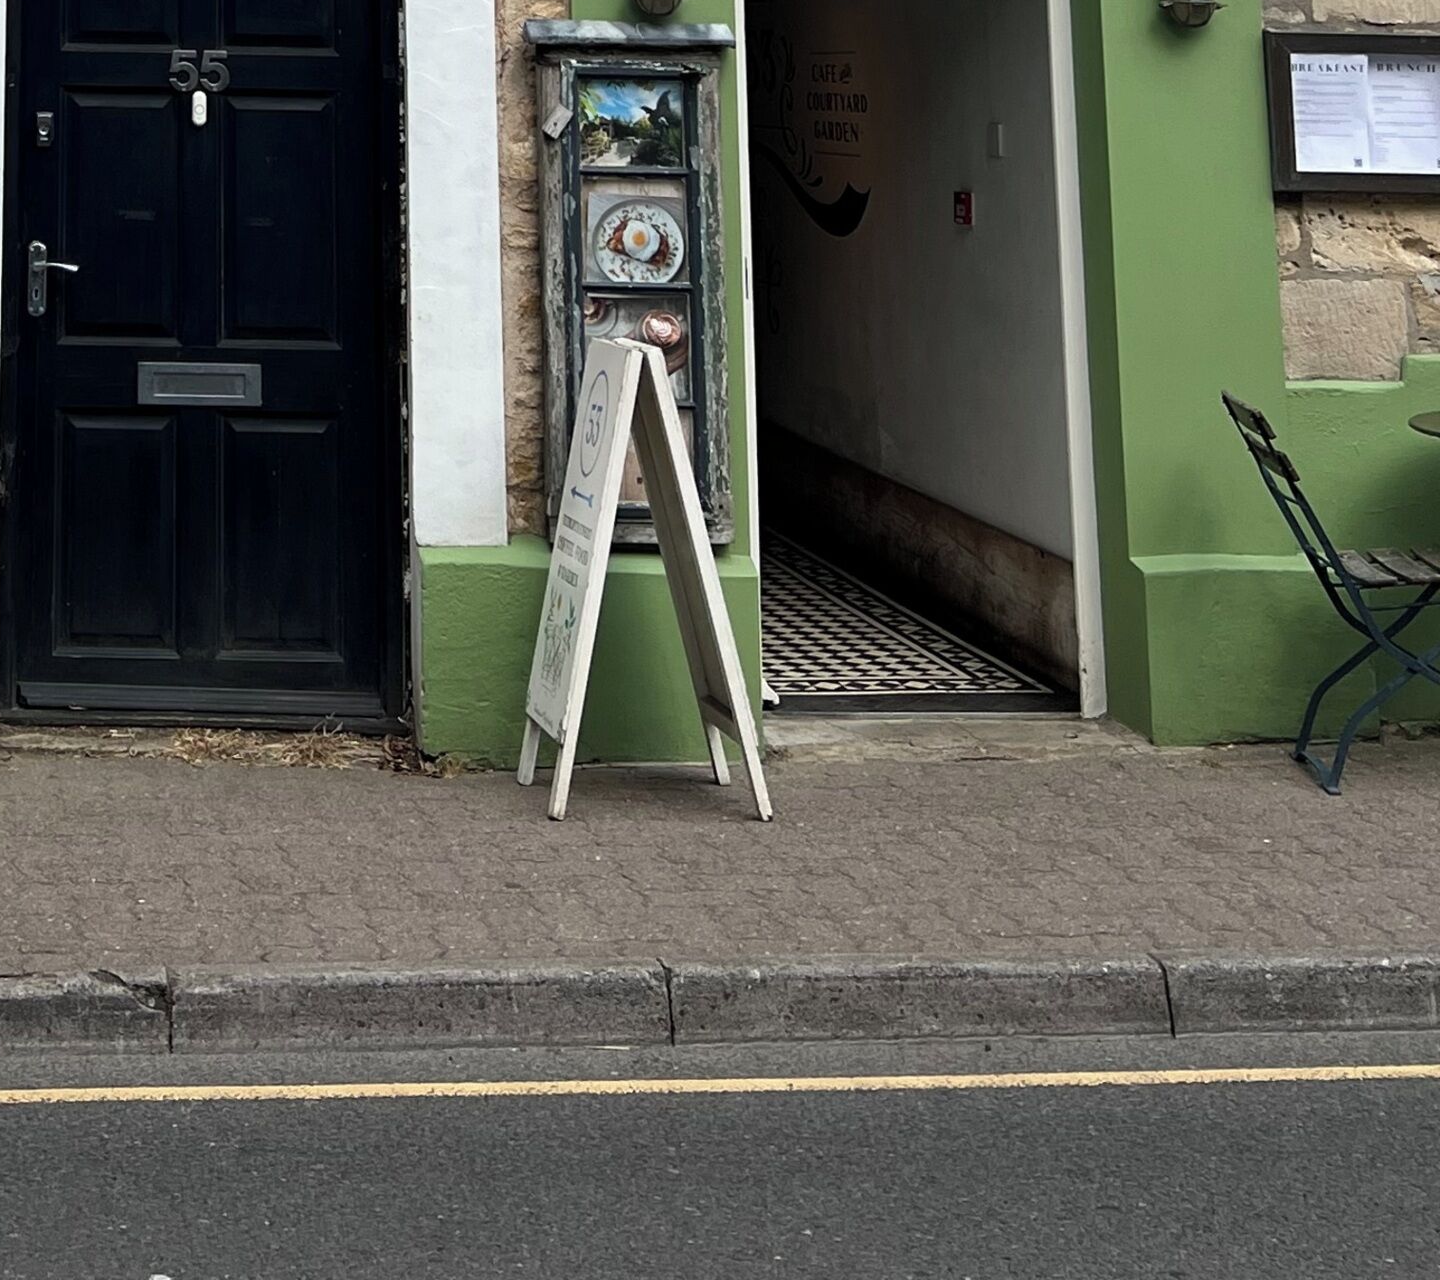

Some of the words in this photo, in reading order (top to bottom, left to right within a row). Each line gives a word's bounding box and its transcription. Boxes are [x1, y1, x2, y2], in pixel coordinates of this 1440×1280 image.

[168, 49, 230, 92] 55
[812, 63, 836, 83] CAFE
[1291, 63, 1365, 73] BREAKFAST
[1376, 63, 1437, 73] BRUNCH
[807, 92, 868, 113] COURTYARD
[814, 120, 859, 142] GARDEN
[585, 403, 604, 448] 53
